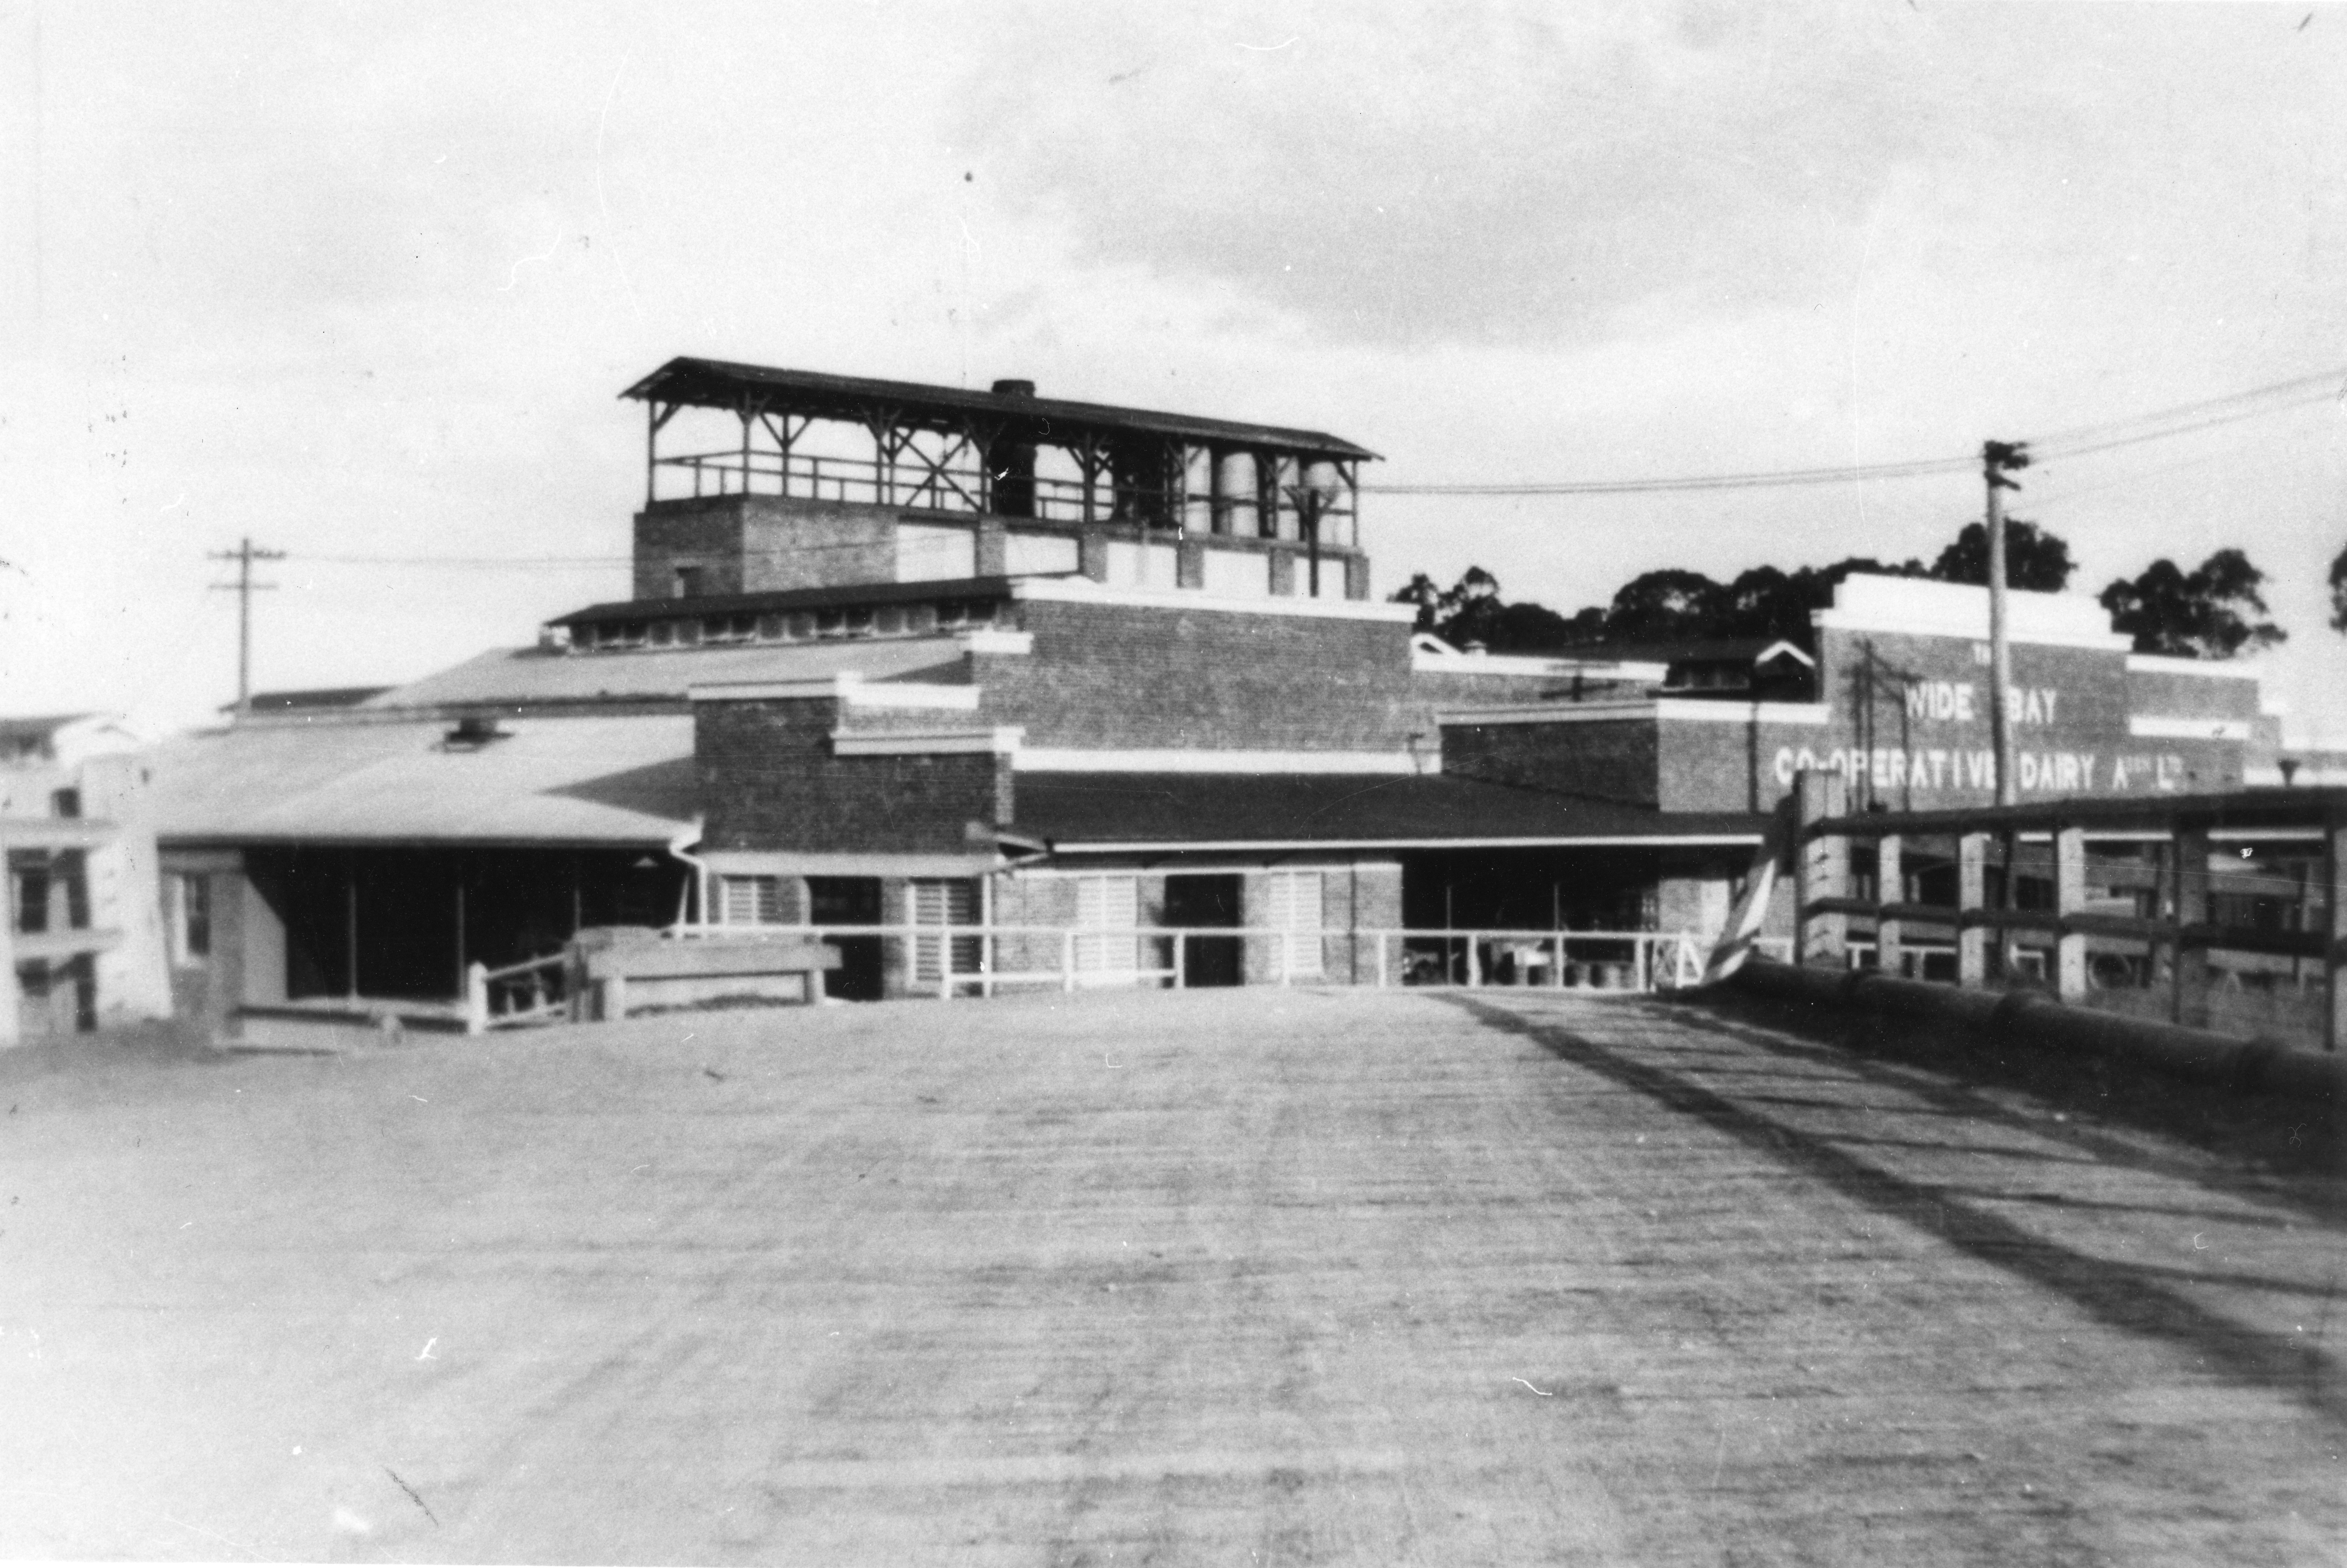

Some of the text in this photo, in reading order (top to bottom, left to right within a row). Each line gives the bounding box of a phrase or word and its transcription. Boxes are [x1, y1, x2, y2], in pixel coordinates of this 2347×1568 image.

[1904, 682, 2057, 724] WIDE BAY
[2020, 751, 2095, 791] DAIRY
